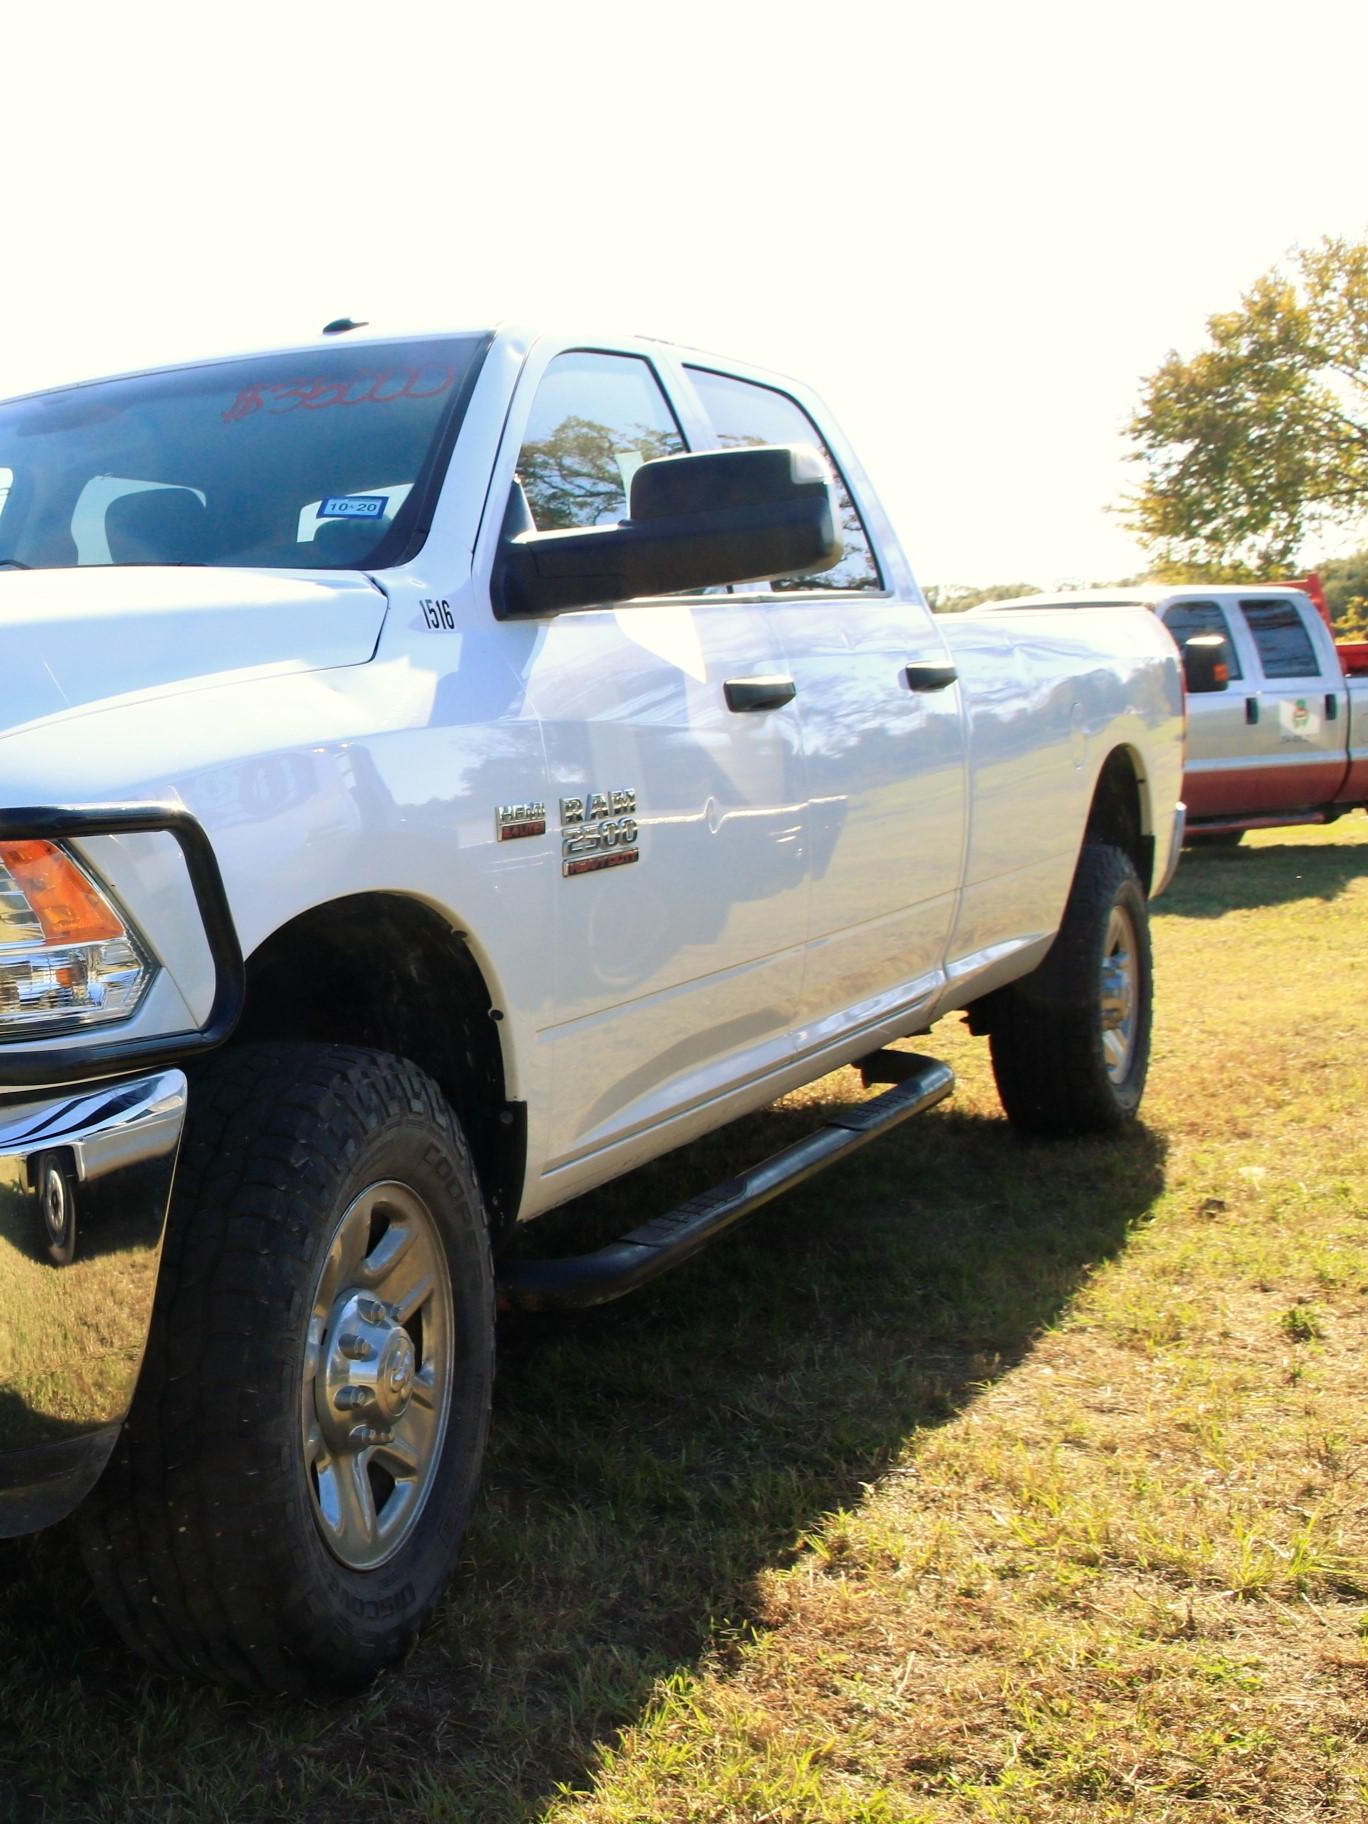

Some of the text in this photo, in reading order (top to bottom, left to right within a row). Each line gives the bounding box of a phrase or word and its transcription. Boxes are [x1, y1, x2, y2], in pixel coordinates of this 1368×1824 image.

[419, 599, 455, 630] 1516
[495, 802, 546, 824] HEMI
[559, 788, 637, 827] RAM
[561, 816, 638, 857] 2500
